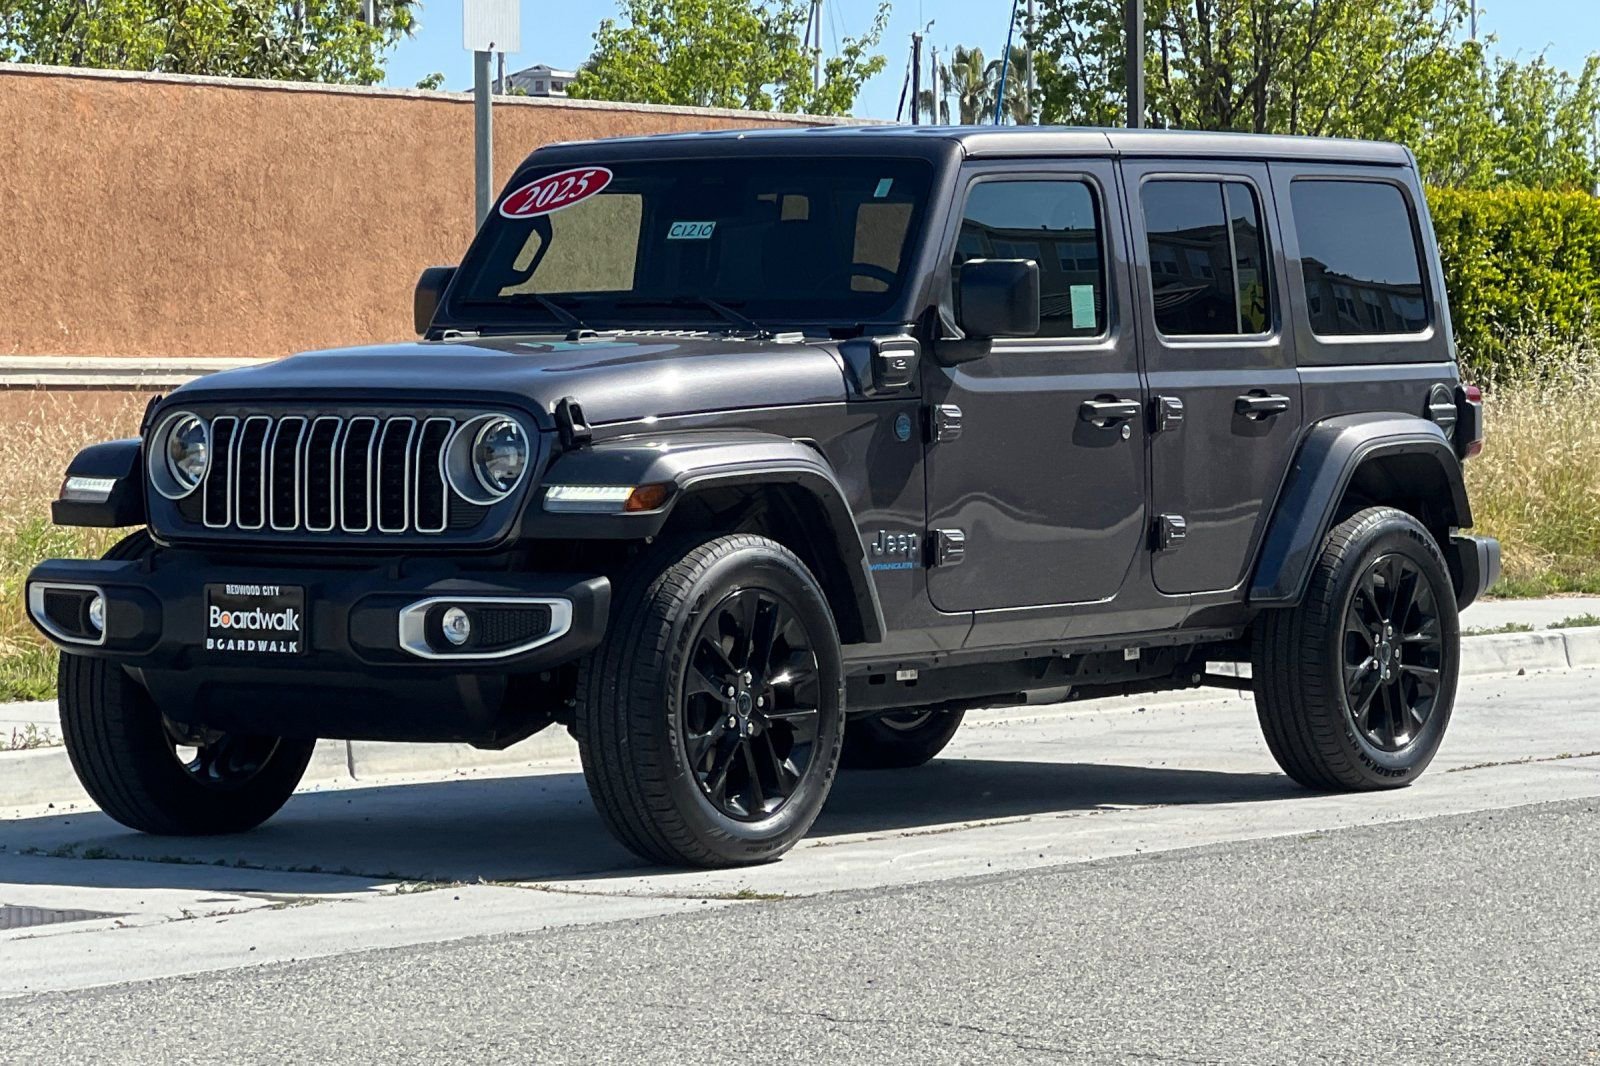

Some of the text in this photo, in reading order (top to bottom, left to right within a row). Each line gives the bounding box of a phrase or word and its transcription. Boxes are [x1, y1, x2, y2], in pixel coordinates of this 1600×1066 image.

[515, 171, 595, 214] 2025
[872, 529, 919, 560] Jeep
[226, 584, 280, 596] REDWOOD CITY
[209, 605, 300, 631] Boardwalk
